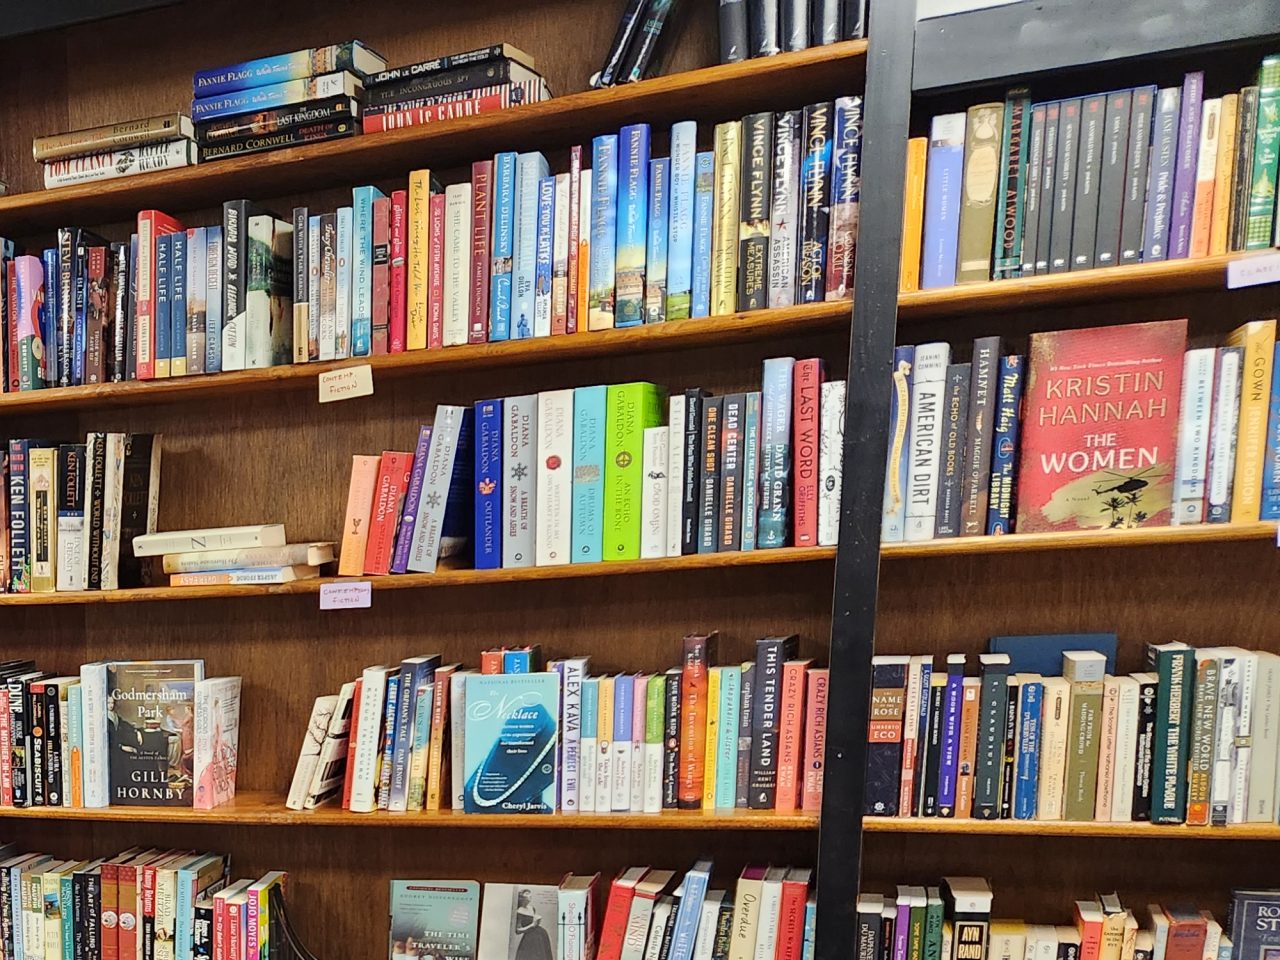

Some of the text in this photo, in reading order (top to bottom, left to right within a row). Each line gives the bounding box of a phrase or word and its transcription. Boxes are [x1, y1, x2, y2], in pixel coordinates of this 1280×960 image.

[374, 69, 401, 82] JOHN
[202, 134, 295, 157] BERNARD CORNWELL
[750, 119, 764, 219] VINCE FLYNN
[1004, 105, 1023, 250] MARGARET ATWOOD
[474, 174, 487, 257] PLANT LIFE
[158, 243, 167, 304] HALF LIFE
[175, 241, 183, 302] HALF LIFE
[976, 347, 990, 406] HAMNET
[1141, 357, 1162, 365] Author
[329, 382, 357, 394] FICTION
[1046, 370, 1164, 399] KRISTIN
[617, 390, 625, 451] GABALDON
[626, 401, 634, 435] DIANA
[1038, 398, 1168, 427] HANNAH
[481, 422, 489, 473] GABALDON
[726, 403, 738, 470] DEAD CENTER
[799, 388, 814, 479] LAST WORD
[911, 392, 936, 506] AMERICAN DIRT
[1083, 433, 1117, 448] THE
[430, 434, 444, 485] GABALDON
[439, 446, 451, 478] DIANA
[1040, 446, 1159, 475] WOMEN
[377, 475, 390, 522] GABALDON
[385, 486, 397, 514] DIANA
[485, 501, 493, 554] OUTLANDER
[8, 684, 23, 713] DUNE
[112, 688, 187, 703] Godmersham
[566, 666, 580, 732] ALEX KAVA
[761, 646, 777, 766] THIS TENDER LAND
[872, 696, 902, 704] NAME
[138, 705, 164, 720] Park
[1199, 670, 1216, 771] BRAVE NEW WORLD
[874, 731, 896, 739] ECO
[34, 738, 43, 795] SEABISCUIT
[131, 770, 170, 783] GILL
[117, 786, 185, 801] HORNBY
[502, 802, 547, 810] Cheryl Jarvis
[248, 893, 257, 947] JOJO MOYES
[737, 893, 757, 940] Overdue
[412, 942, 470, 950] TRAVELER'S
[962, 927, 979, 941] AYN
[958, 944, 981, 959] RAND
